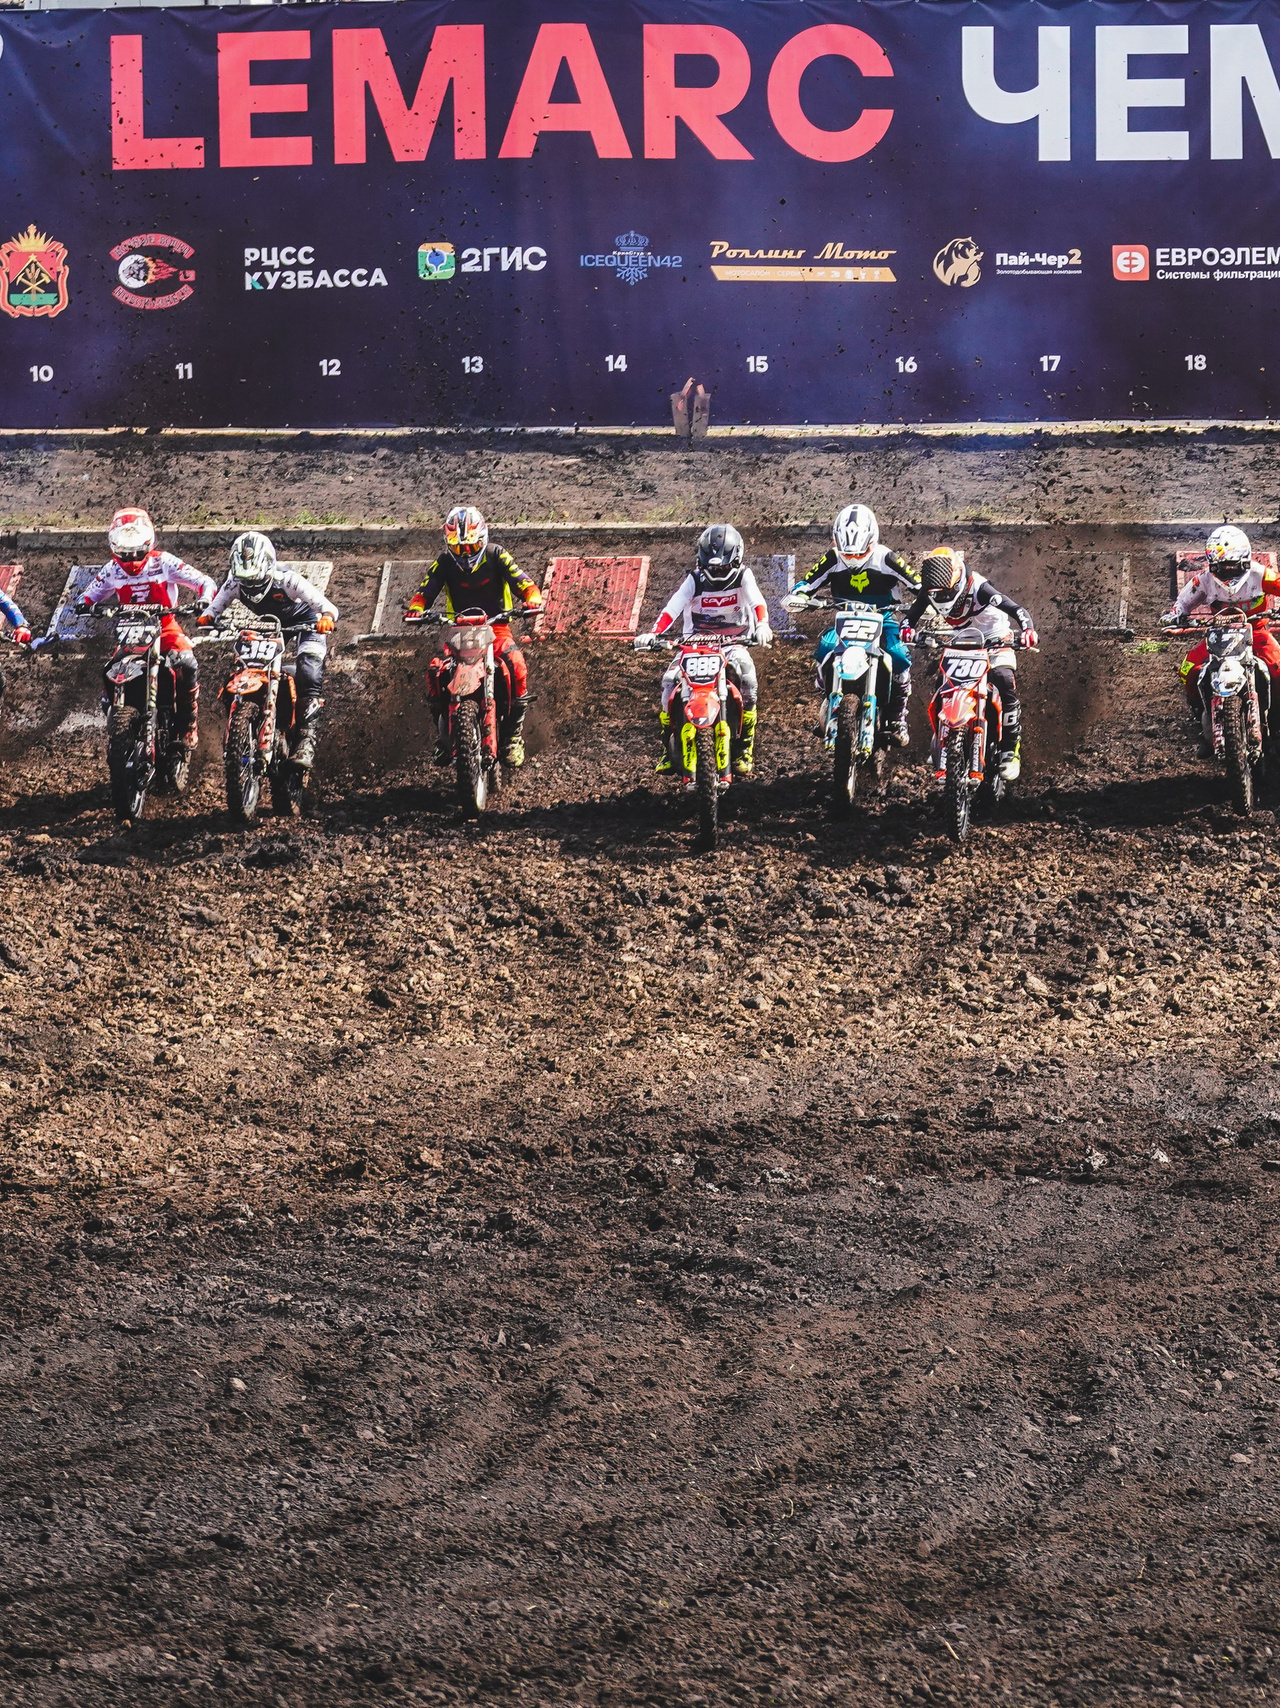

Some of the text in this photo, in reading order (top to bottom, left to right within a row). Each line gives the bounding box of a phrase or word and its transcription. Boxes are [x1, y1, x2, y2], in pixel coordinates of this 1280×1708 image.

[111, 22, 895, 170] LEMARC
[244, 246, 315, 268] РЦСС
[709, 240, 897, 260] Роллинг Мото
[461, 246, 547, 272] 2ГИС
[580, 254, 682, 268] ICEQUEEN42
[245, 267, 388, 290] КУЗБАССА
[1156, 269, 1210, 280] Системы
[320, 359, 340, 375] 12
[462, 356, 483, 373] 13
[606, 355, 627, 371] 14
[747, 356, 768, 372] 15
[896, 357, 917, 372] 16
[1040, 356, 1060, 371] 17
[1185, 355, 1206, 370] 18
[30, 366, 53, 381] 10
[176, 363, 192, 379] 11
[841, 619, 878, 640] 22
[686, 656, 720, 677] 888
[947, 659, 988, 678] 730
